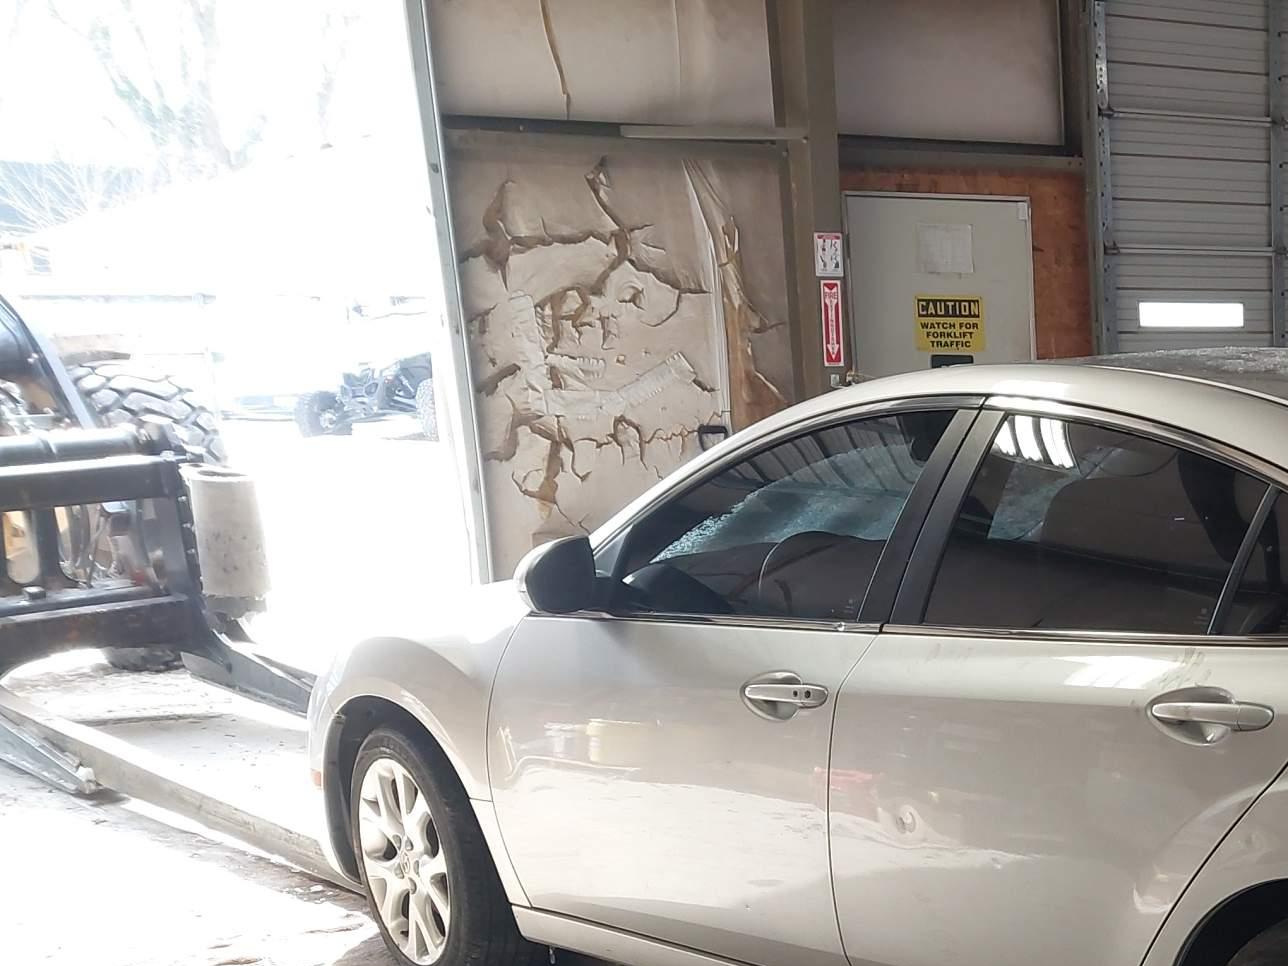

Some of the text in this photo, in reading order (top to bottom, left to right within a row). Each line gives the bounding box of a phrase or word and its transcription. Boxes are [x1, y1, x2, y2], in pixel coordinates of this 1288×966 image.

[824, 291, 838, 299] FIRE
[918, 301, 979, 316] CAUTION
[920, 322, 979, 330] WATCH FOR
[926, 331, 975, 339] FORKLIFT
[930, 340, 972, 348] TRAFFIC
